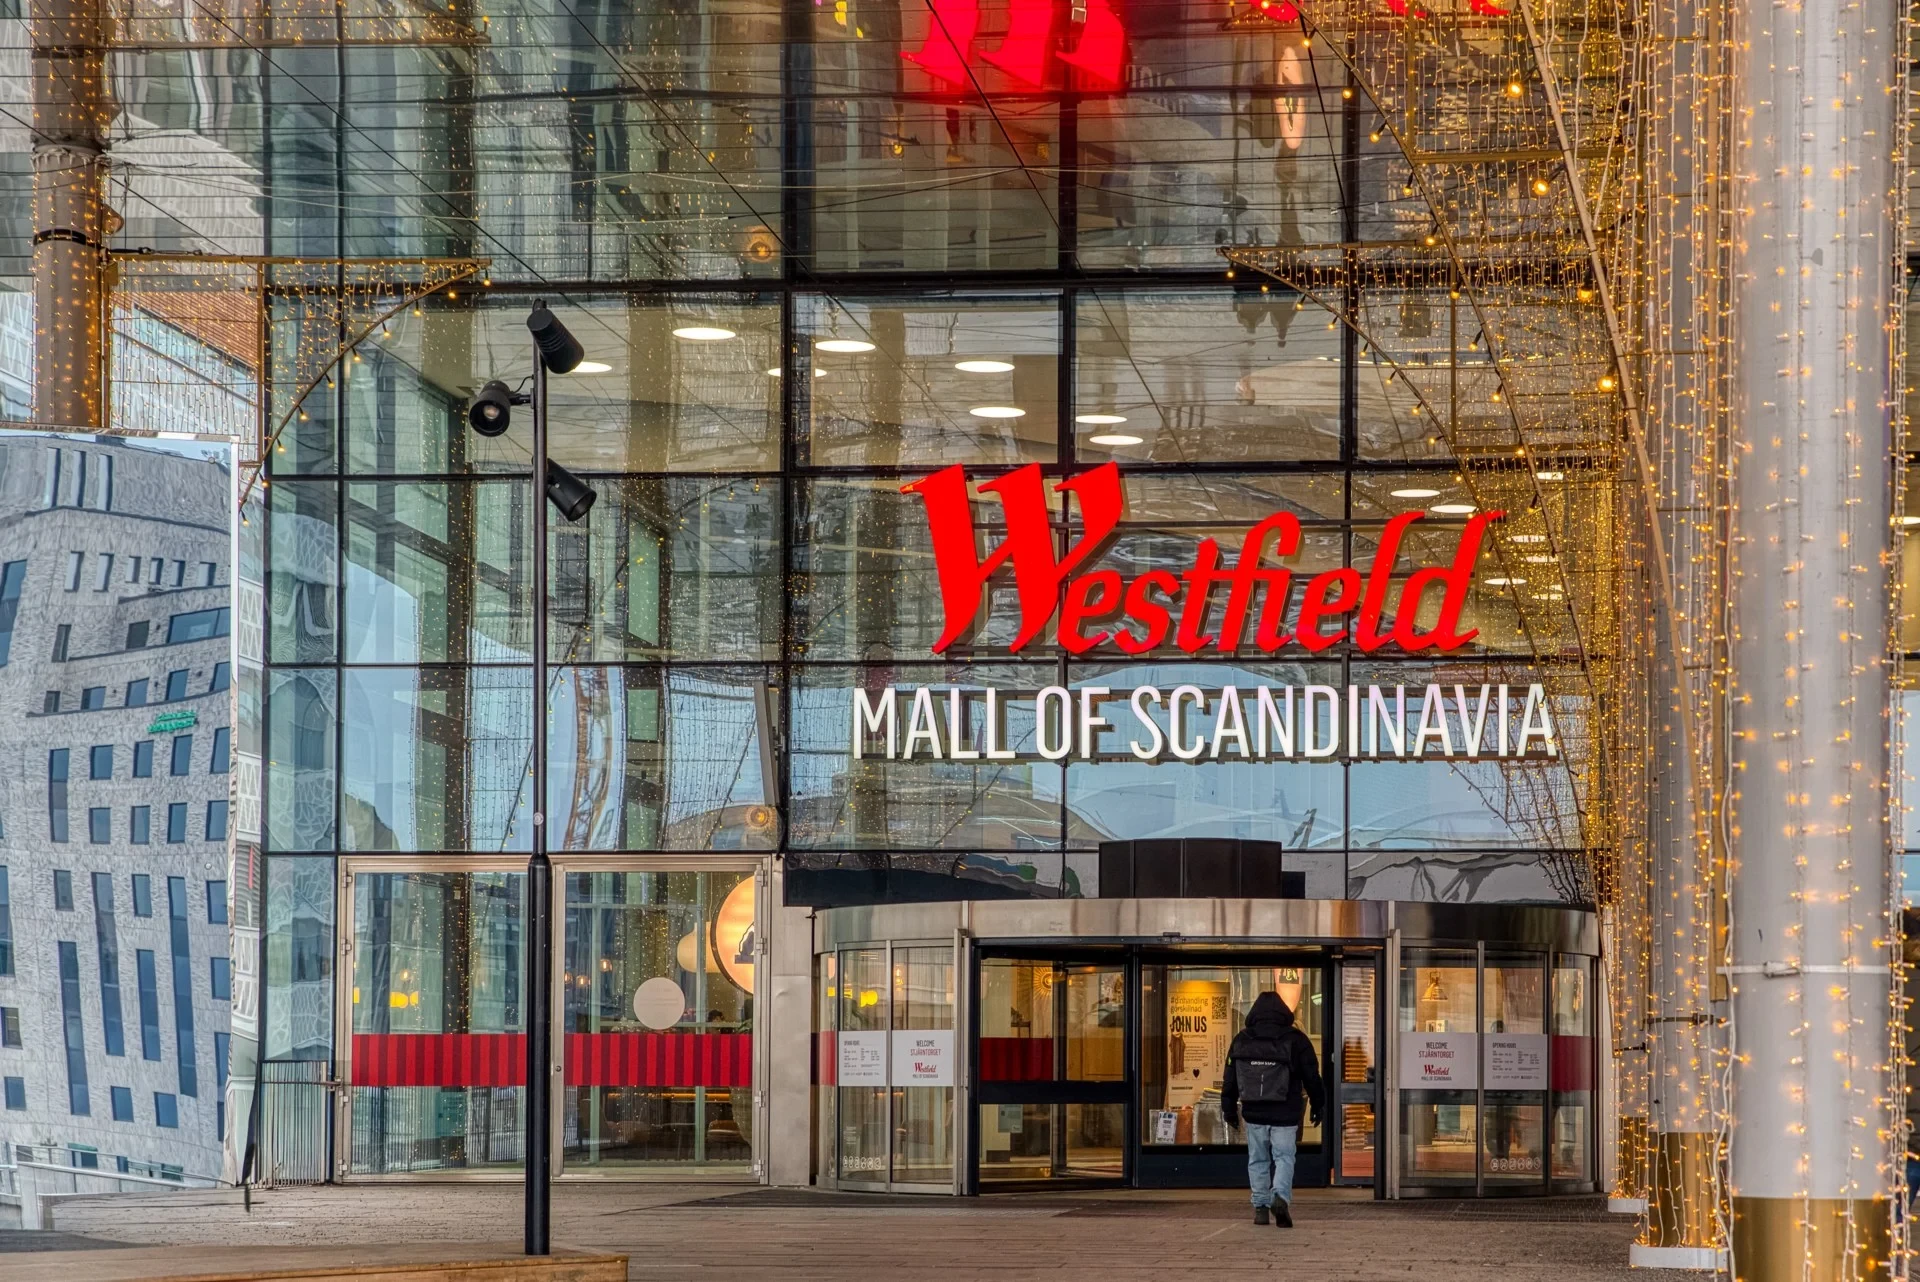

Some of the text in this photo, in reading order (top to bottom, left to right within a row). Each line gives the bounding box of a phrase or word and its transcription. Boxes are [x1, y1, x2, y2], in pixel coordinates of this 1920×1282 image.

[901, 462, 1507, 654] Westfield
[852, 684, 1558, 759] MALL OF SCANDINAVIA
[1171, 1016, 1207, 1032] JOIN US
[1424, 1064, 1450, 1075] Westfield
